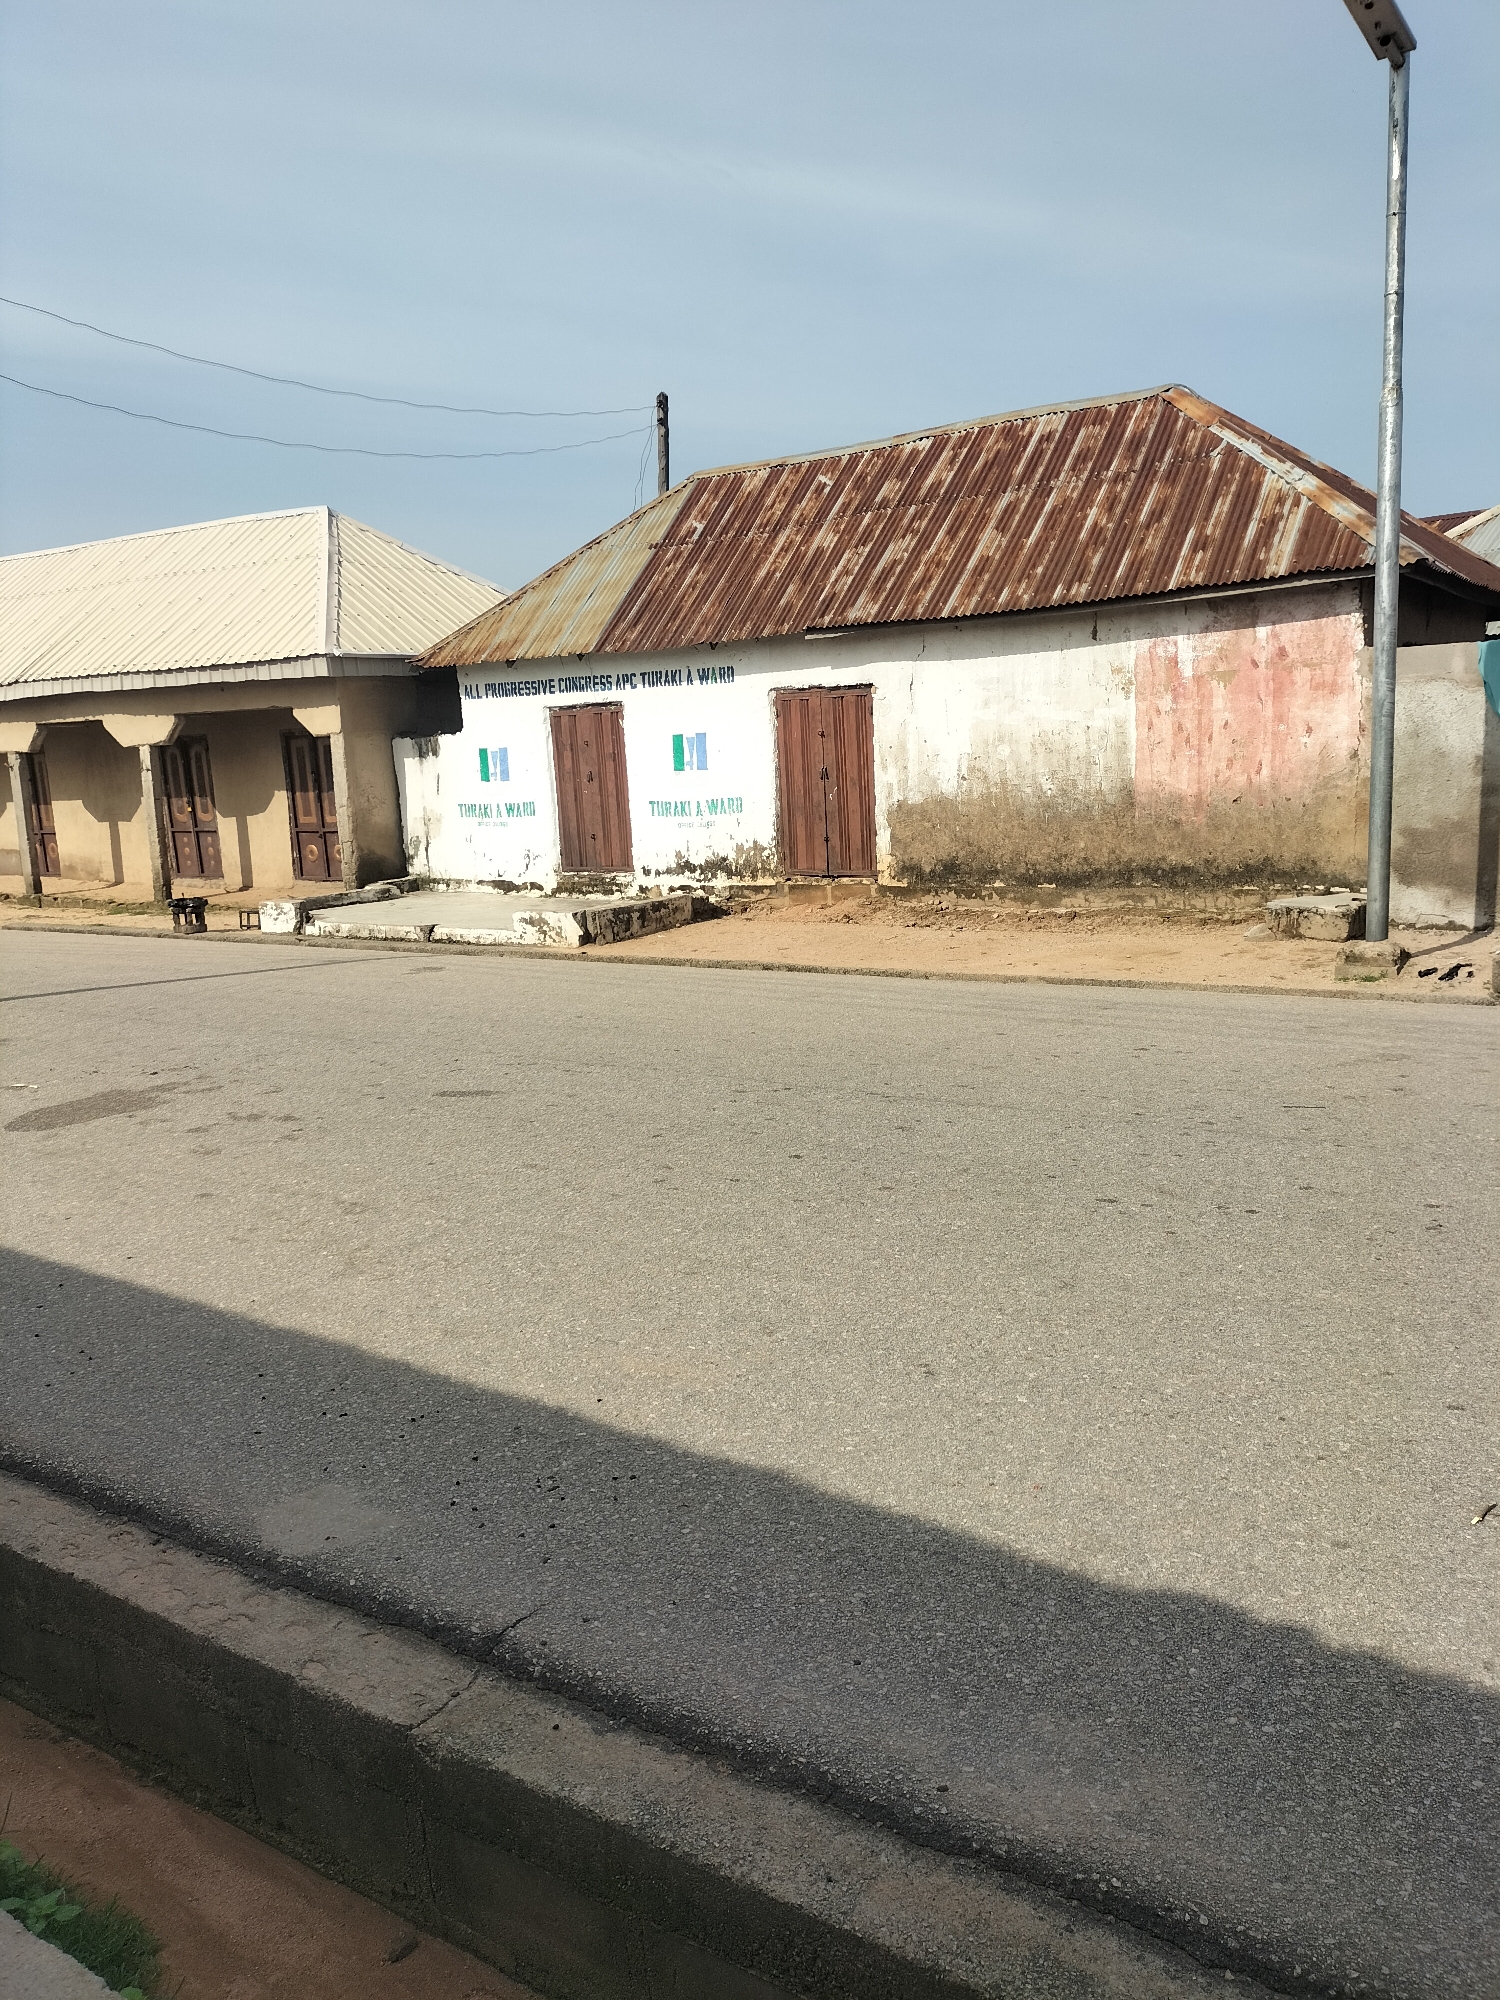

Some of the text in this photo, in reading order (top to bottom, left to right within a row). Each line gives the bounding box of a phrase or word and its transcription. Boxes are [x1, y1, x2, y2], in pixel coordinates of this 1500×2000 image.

[464, 683, 482, 700] ALL
[484, 679, 556, 699] PROGRESSIVE
[558, 674, 613, 694] CONGRESS
[615, 672, 637, 691] APC
[639, 668, 682, 689] TURAKI
[697, 665, 735, 686] WARD
[458, 801, 536, 819] TURAKI A WARD
[649, 796, 743, 817] TURAKI A WARD
